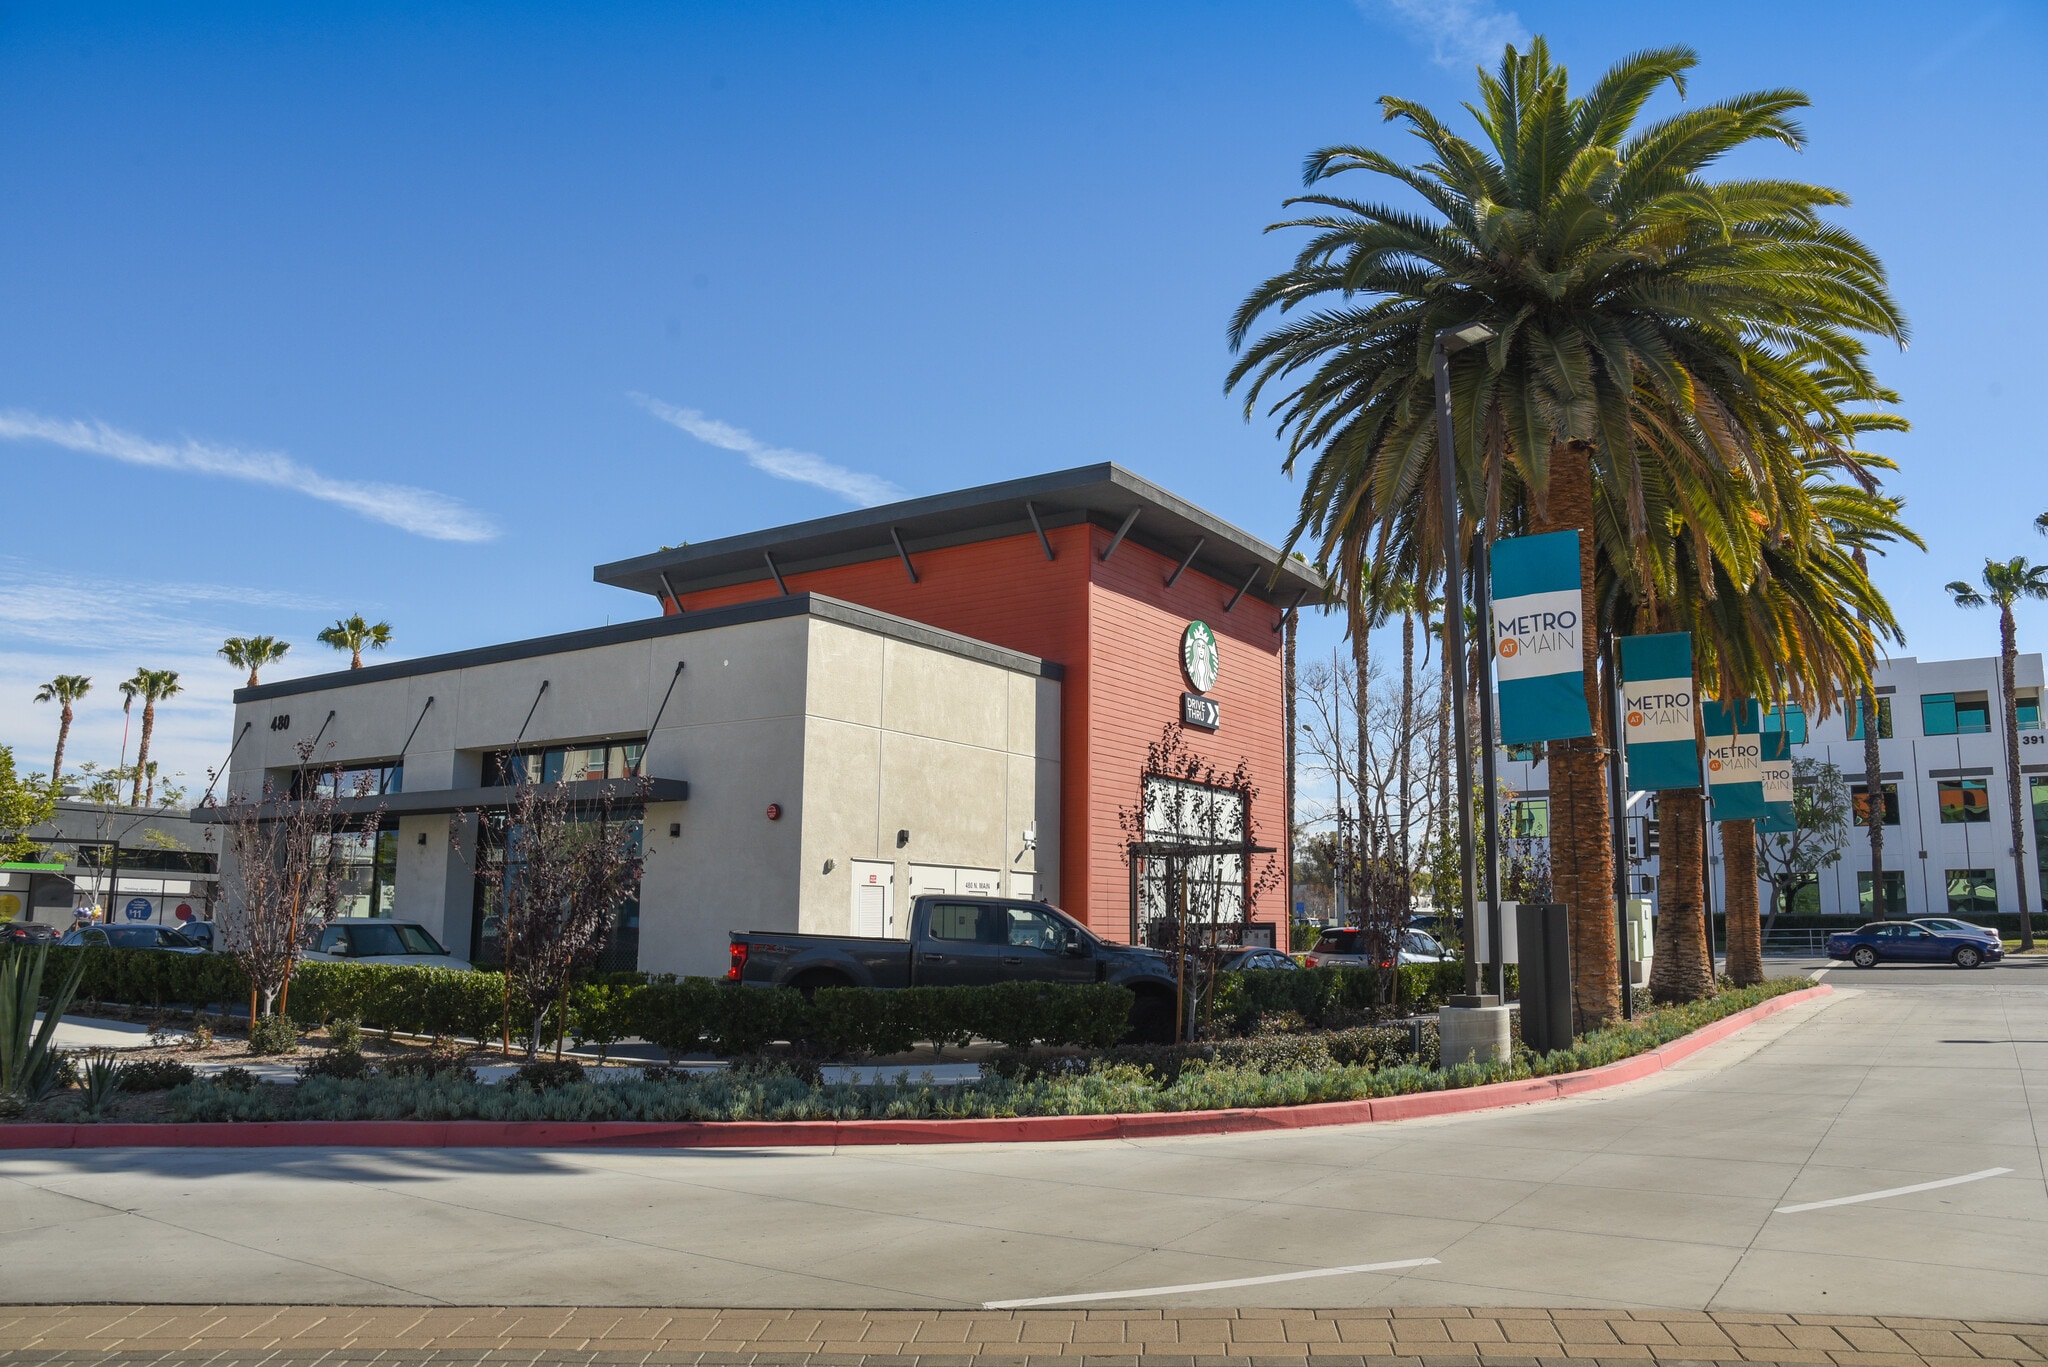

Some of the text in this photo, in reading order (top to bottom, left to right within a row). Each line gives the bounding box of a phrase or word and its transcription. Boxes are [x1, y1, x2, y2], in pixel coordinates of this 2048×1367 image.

[1498, 610, 1577, 638] METRO
[1502, 630, 1575, 657] AT MAIN
[1187, 697, 1206, 712] DRIVE
[1627, 692, 1690, 711] METRO
[1187, 707, 1205, 722] THRU
[1630, 708, 1689, 726] AT MAIN
[270, 714, 290, 731] 480
[2022, 735, 2045, 745] 391
[1708, 745, 1759, 759] METRO
[1721, 757, 1758, 771] MAIN
[1761, 770, 1790, 781] TRO
